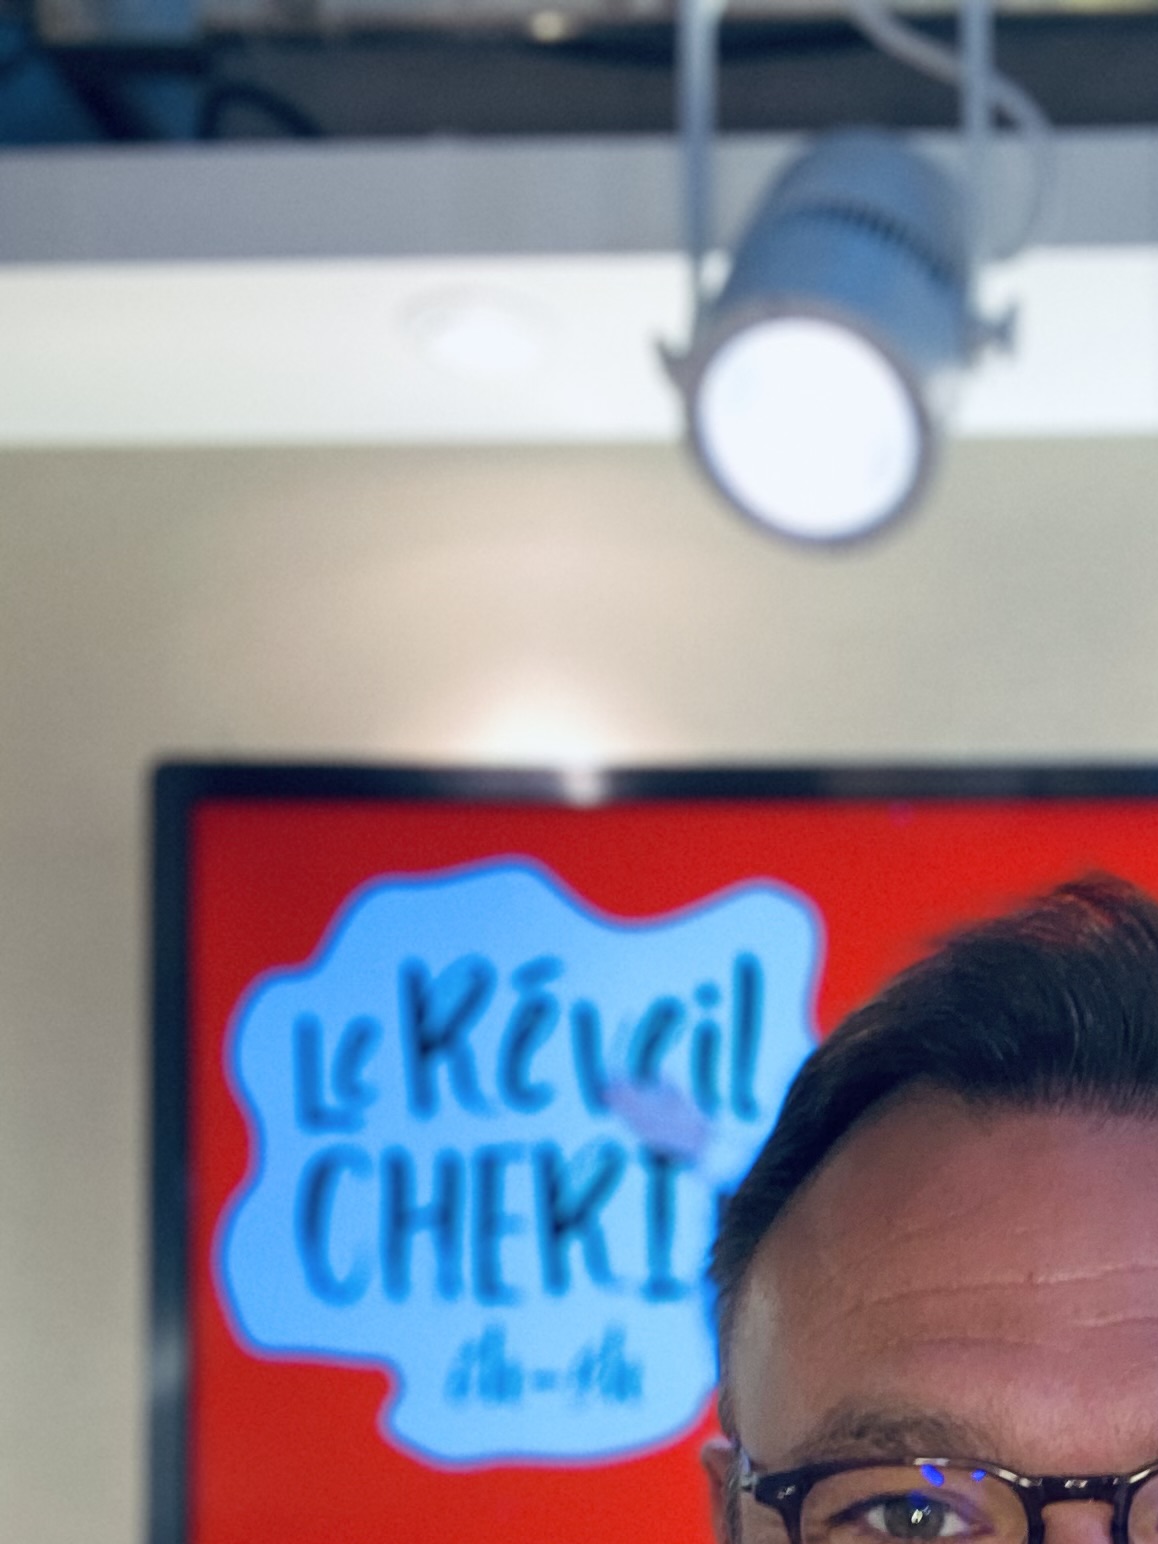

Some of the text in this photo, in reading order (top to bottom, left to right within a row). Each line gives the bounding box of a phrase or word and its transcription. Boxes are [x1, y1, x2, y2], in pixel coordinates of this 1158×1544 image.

[293, 950, 764, 1133] Le Réveil
[295, 1142, 712, 1303] CHERI
